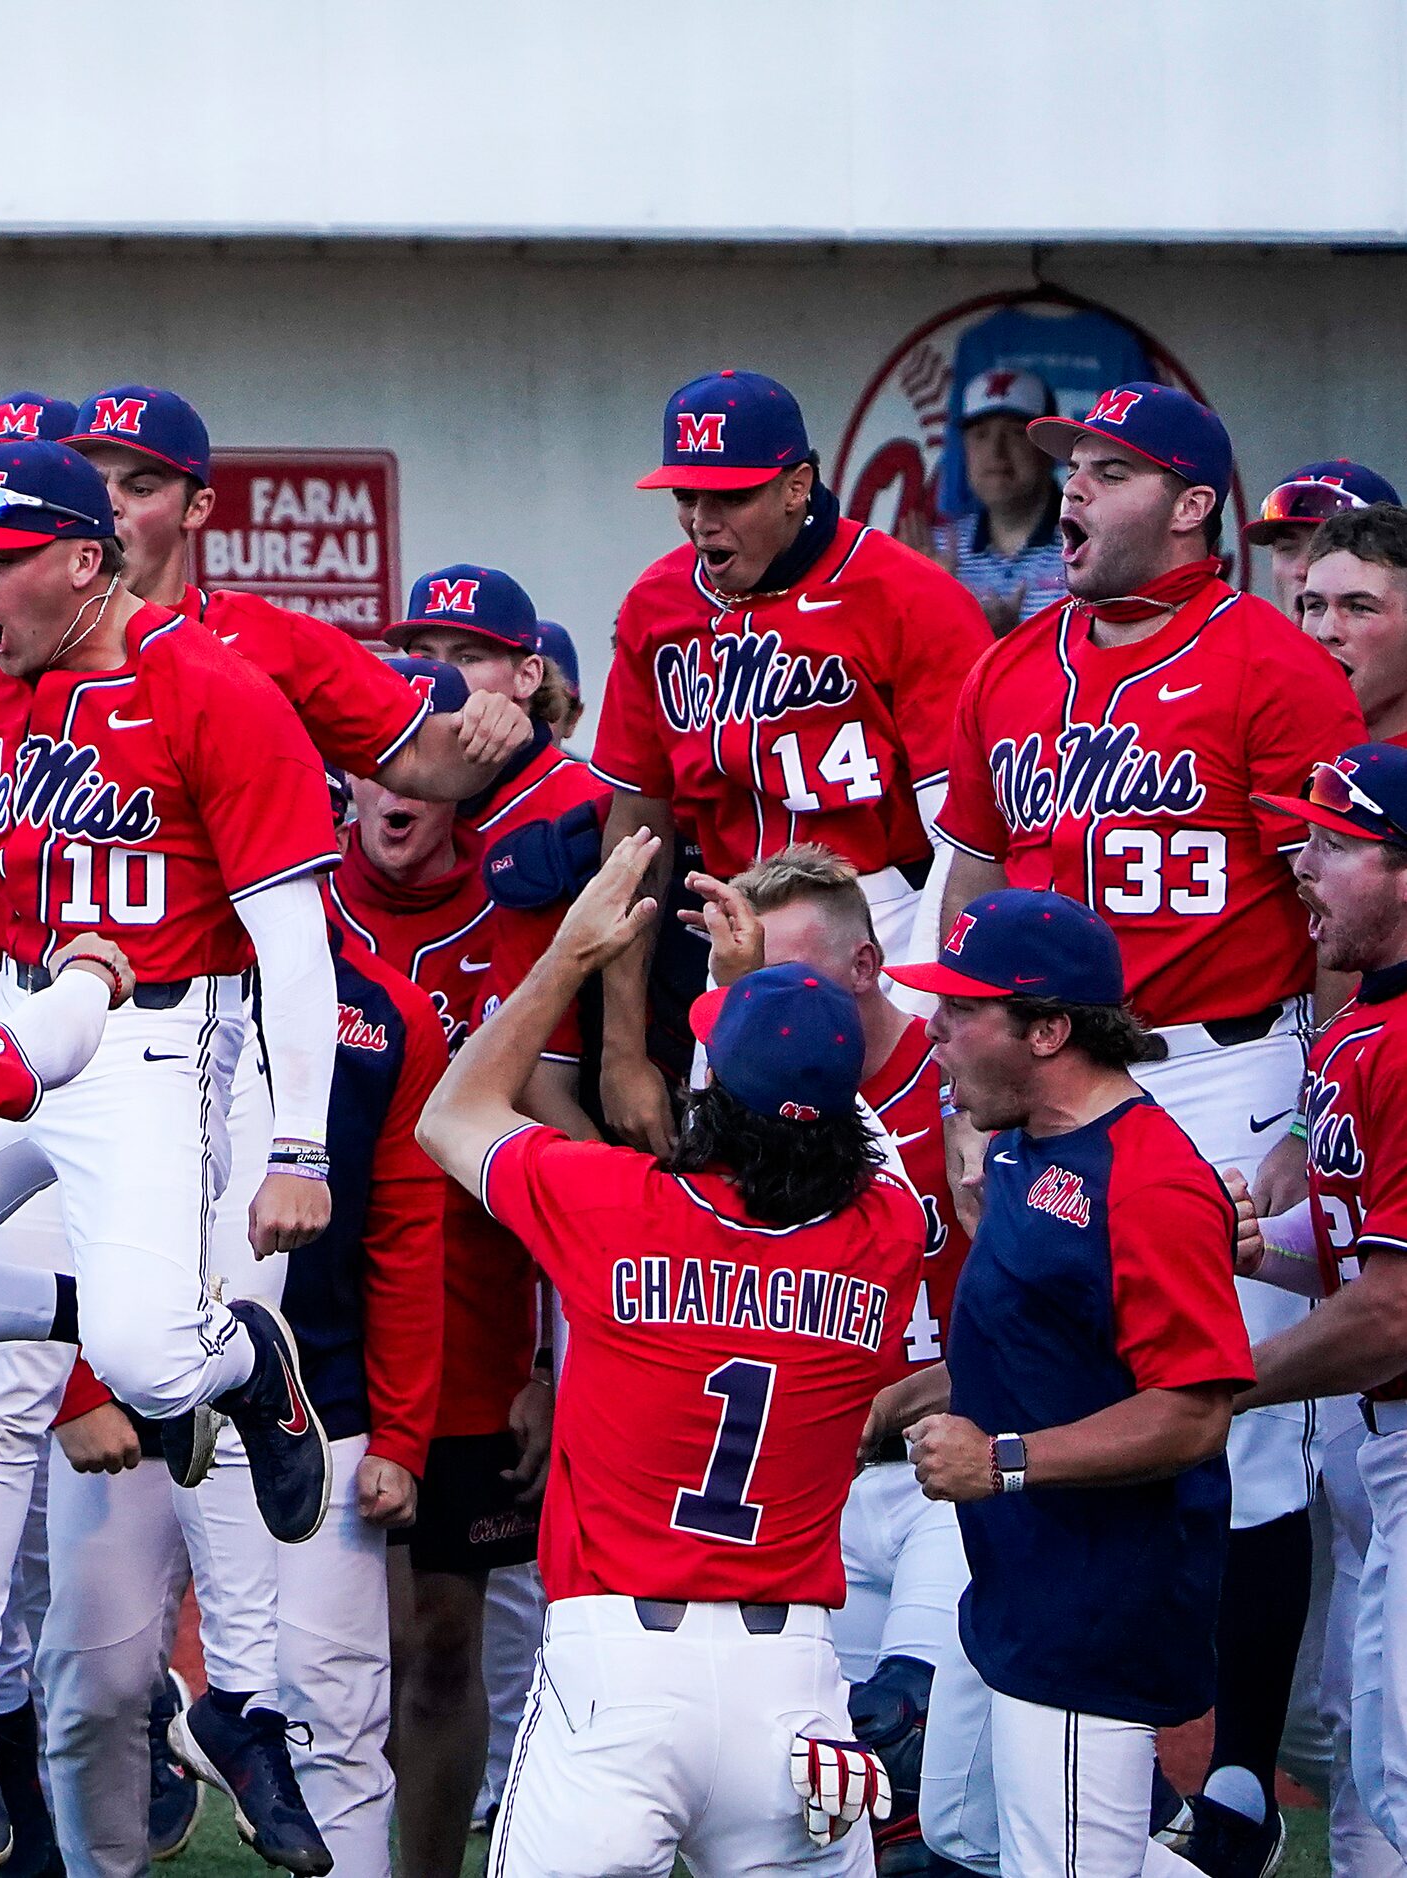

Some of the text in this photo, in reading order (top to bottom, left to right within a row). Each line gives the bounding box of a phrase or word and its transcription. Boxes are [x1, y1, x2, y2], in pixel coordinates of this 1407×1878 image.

[90, 397, 146, 433] M
[676, 413, 726, 452] M
[1084, 389, 1143, 424] M
[250, 477, 377, 527] FARM
[203, 529, 379, 580] BUREAU
[424, 578, 480, 614] M
[655, 629, 857, 733] Ole Miss
[13, 734, 161, 845] Miss
[770, 720, 883, 813] 14
[989, 722, 1206, 834] Ole Miss
[60, 842, 167, 925] 10
[491, 855, 514, 872] M
[1104, 829, 1227, 915] 33
[1027, 1164, 1091, 1228] Ole Miss
[610, 1255, 889, 1353] CHATAGNIER
[668, 1356, 778, 1547] 1
